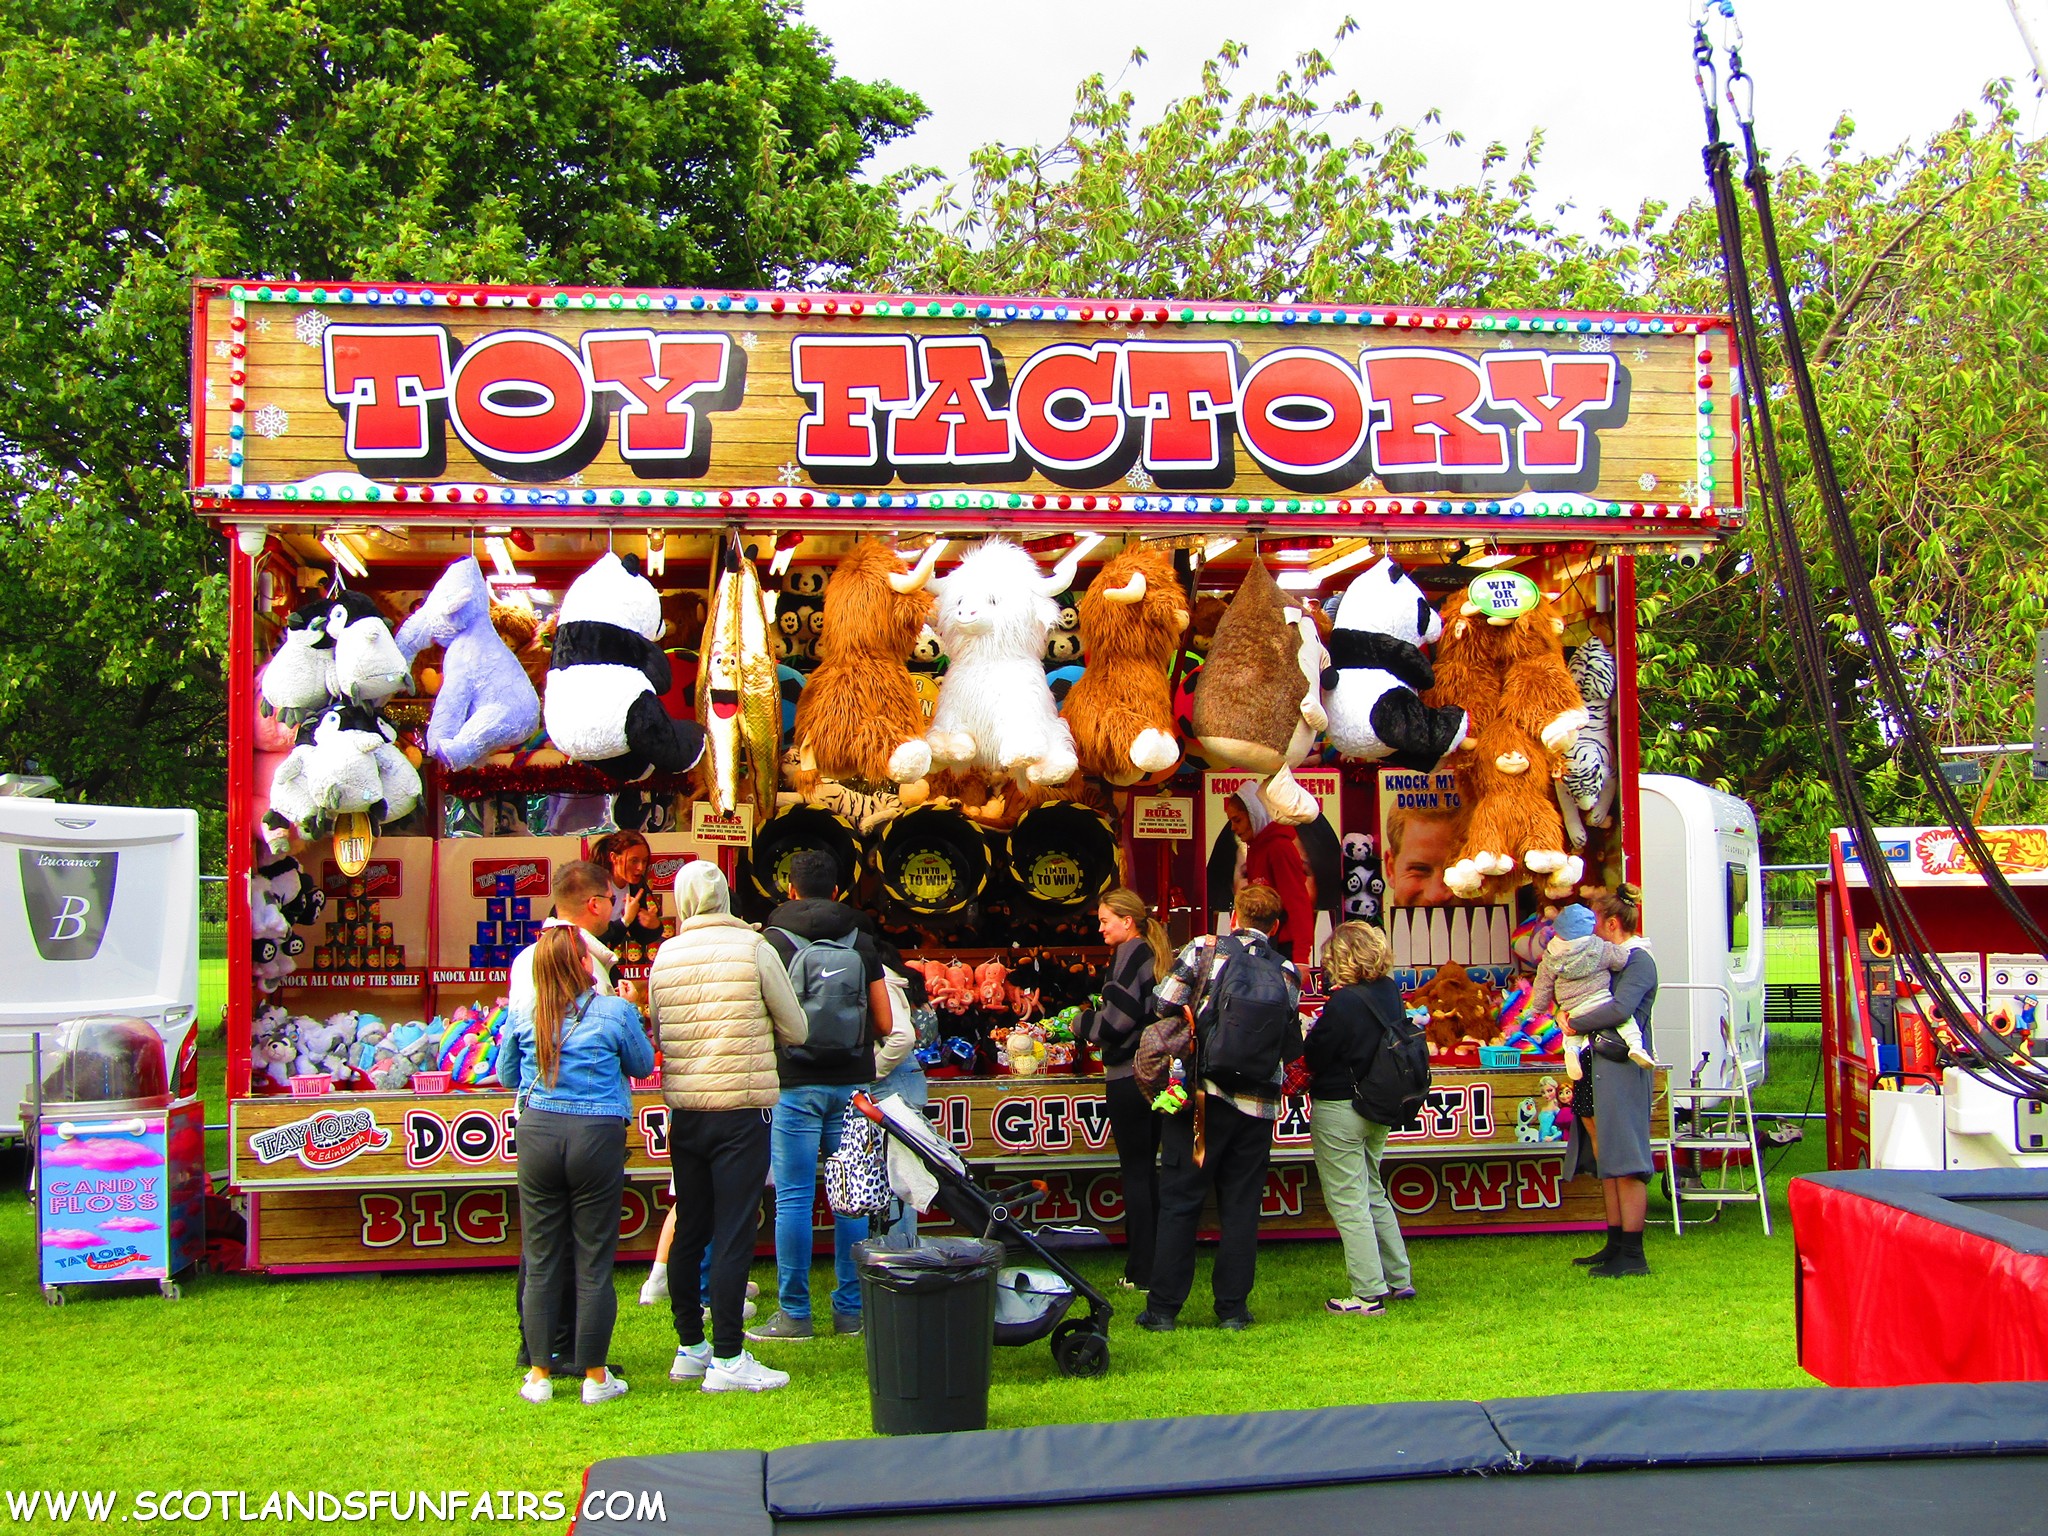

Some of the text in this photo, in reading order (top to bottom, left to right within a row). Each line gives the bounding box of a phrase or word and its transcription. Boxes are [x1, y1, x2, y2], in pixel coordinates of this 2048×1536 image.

[323, 322, 1620, 478] TOY FACTORY
[1486, 580, 1516, 590] WIN
[1494, 590, 1513, 599] OR
[1492, 598, 1519, 608] BUY
[1385, 775, 1430, 791] KNOCK
[1397, 793, 1438, 809] DOWN
[1144, 808, 1182, 818] RULES
[340, 837, 366, 863] WIN
[38, 854, 102, 868] Buccaneer
[908, 873, 948, 886] TO WIN
[1036, 873, 1076, 886] TO WIN
[49, 895, 91, 940] B
[311, 975, 328, 986] ALL
[331, 975, 350, 986] CAN
[352, 975, 366, 986] OF
[368, 975, 388, 986] THE
[390, 975, 420, 986] SHELF
[433, 970, 507, 982] KNOCK ALL CAN
[623, 967, 642, 979] ALL
[255, 1111, 371, 1159] TAYLORS
[318, 1134, 366, 1161] Edinburgh
[49, 1176, 159, 1196] CANDY
[49, 1192, 159, 1215] FLOSS
[360, 1189, 510, 1250] BIG
[55, 1245, 138, 1269] TAYLORS
